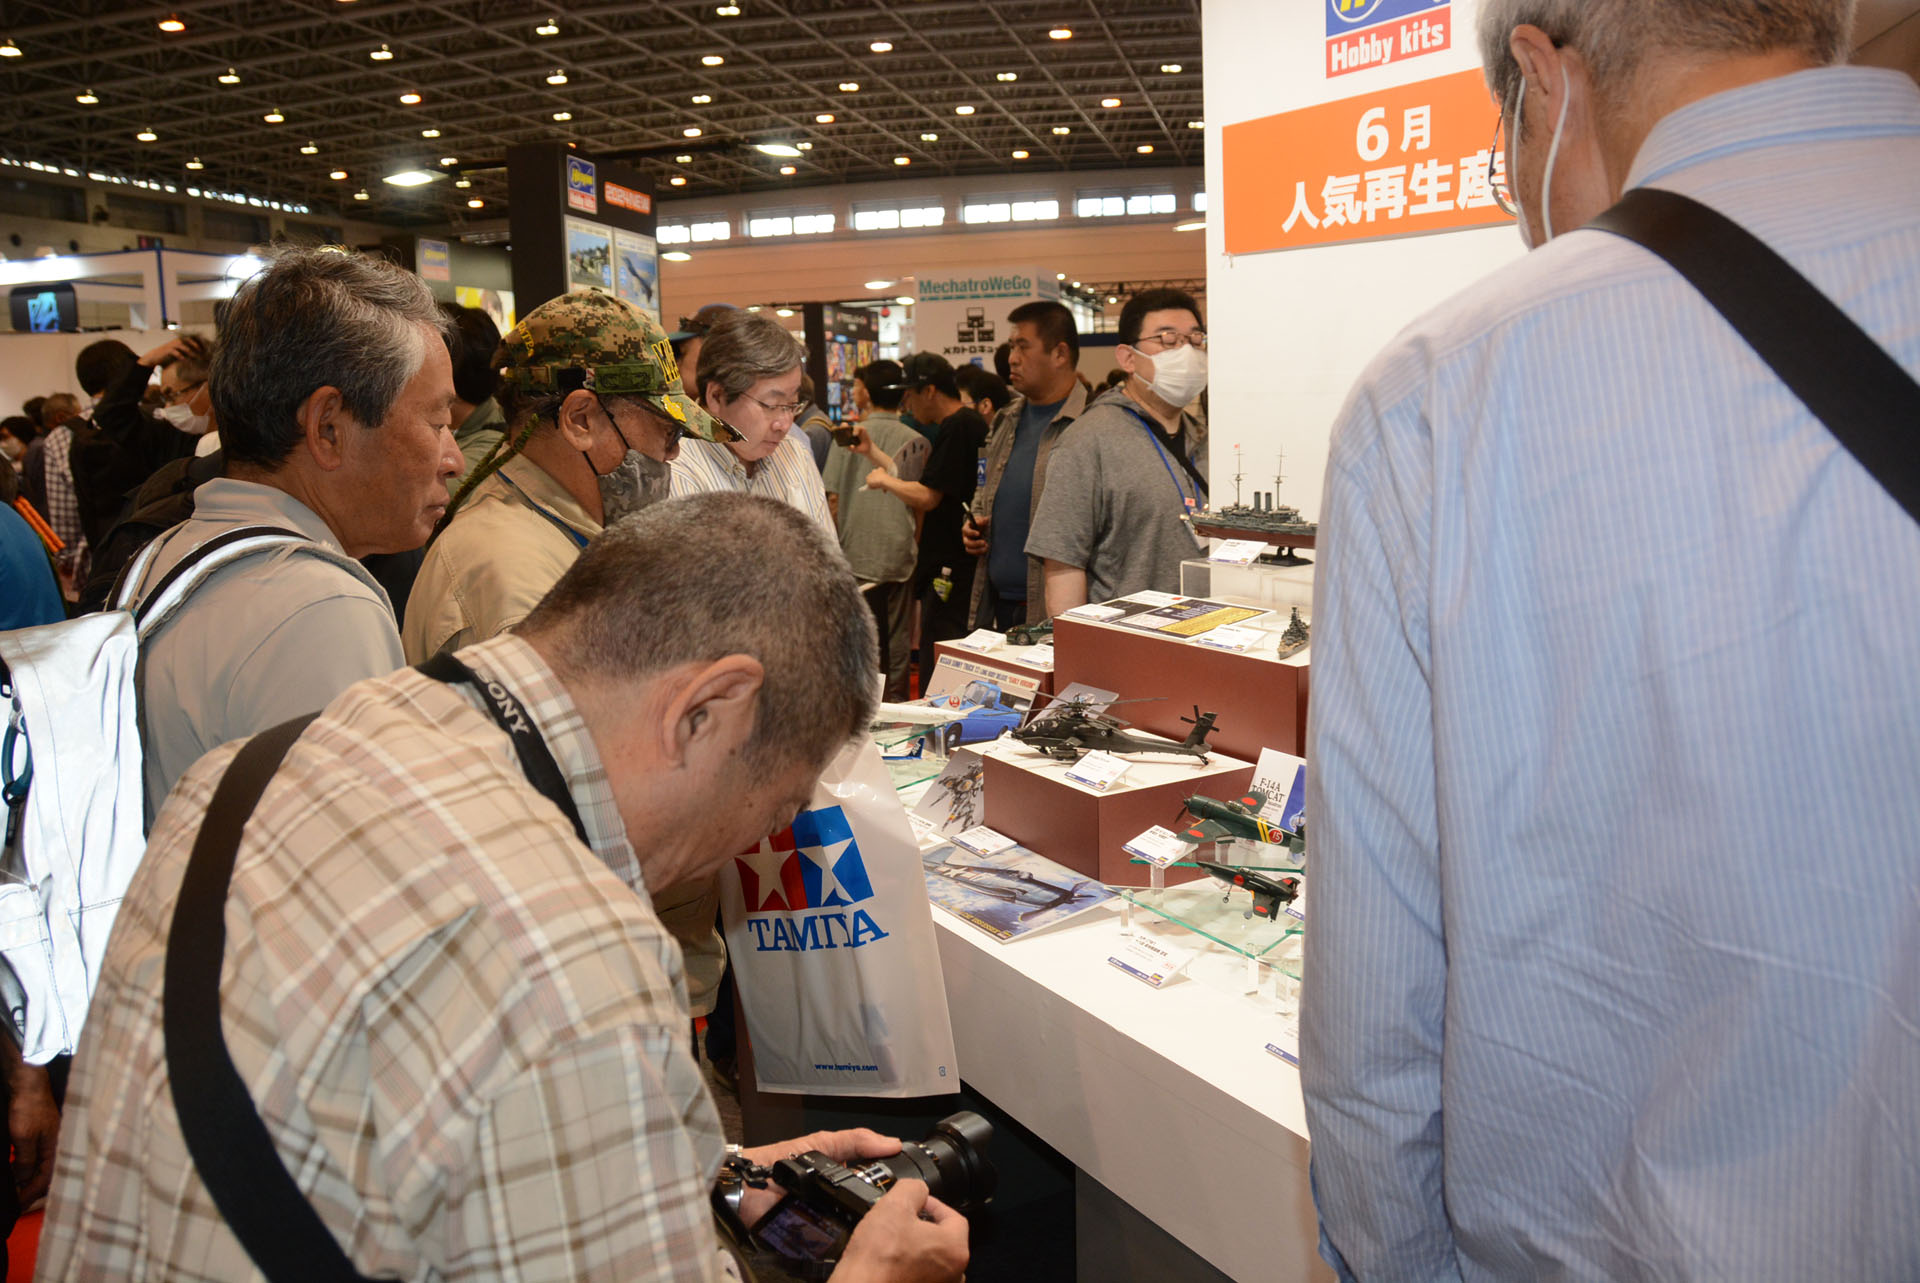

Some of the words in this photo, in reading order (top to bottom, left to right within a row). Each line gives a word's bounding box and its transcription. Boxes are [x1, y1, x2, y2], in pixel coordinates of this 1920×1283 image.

[1331, 33, 1393, 73] Hobby
[1400, 19, 1444, 55] kits
[1356, 104, 1431, 162] 6月
[1281, 149, 1507, 233] 人気再生産
[919, 275, 1032, 295] MechatroWeGo
[1272, 831, 1281, 841] 15
[747, 908, 890, 952] TAMIYA
